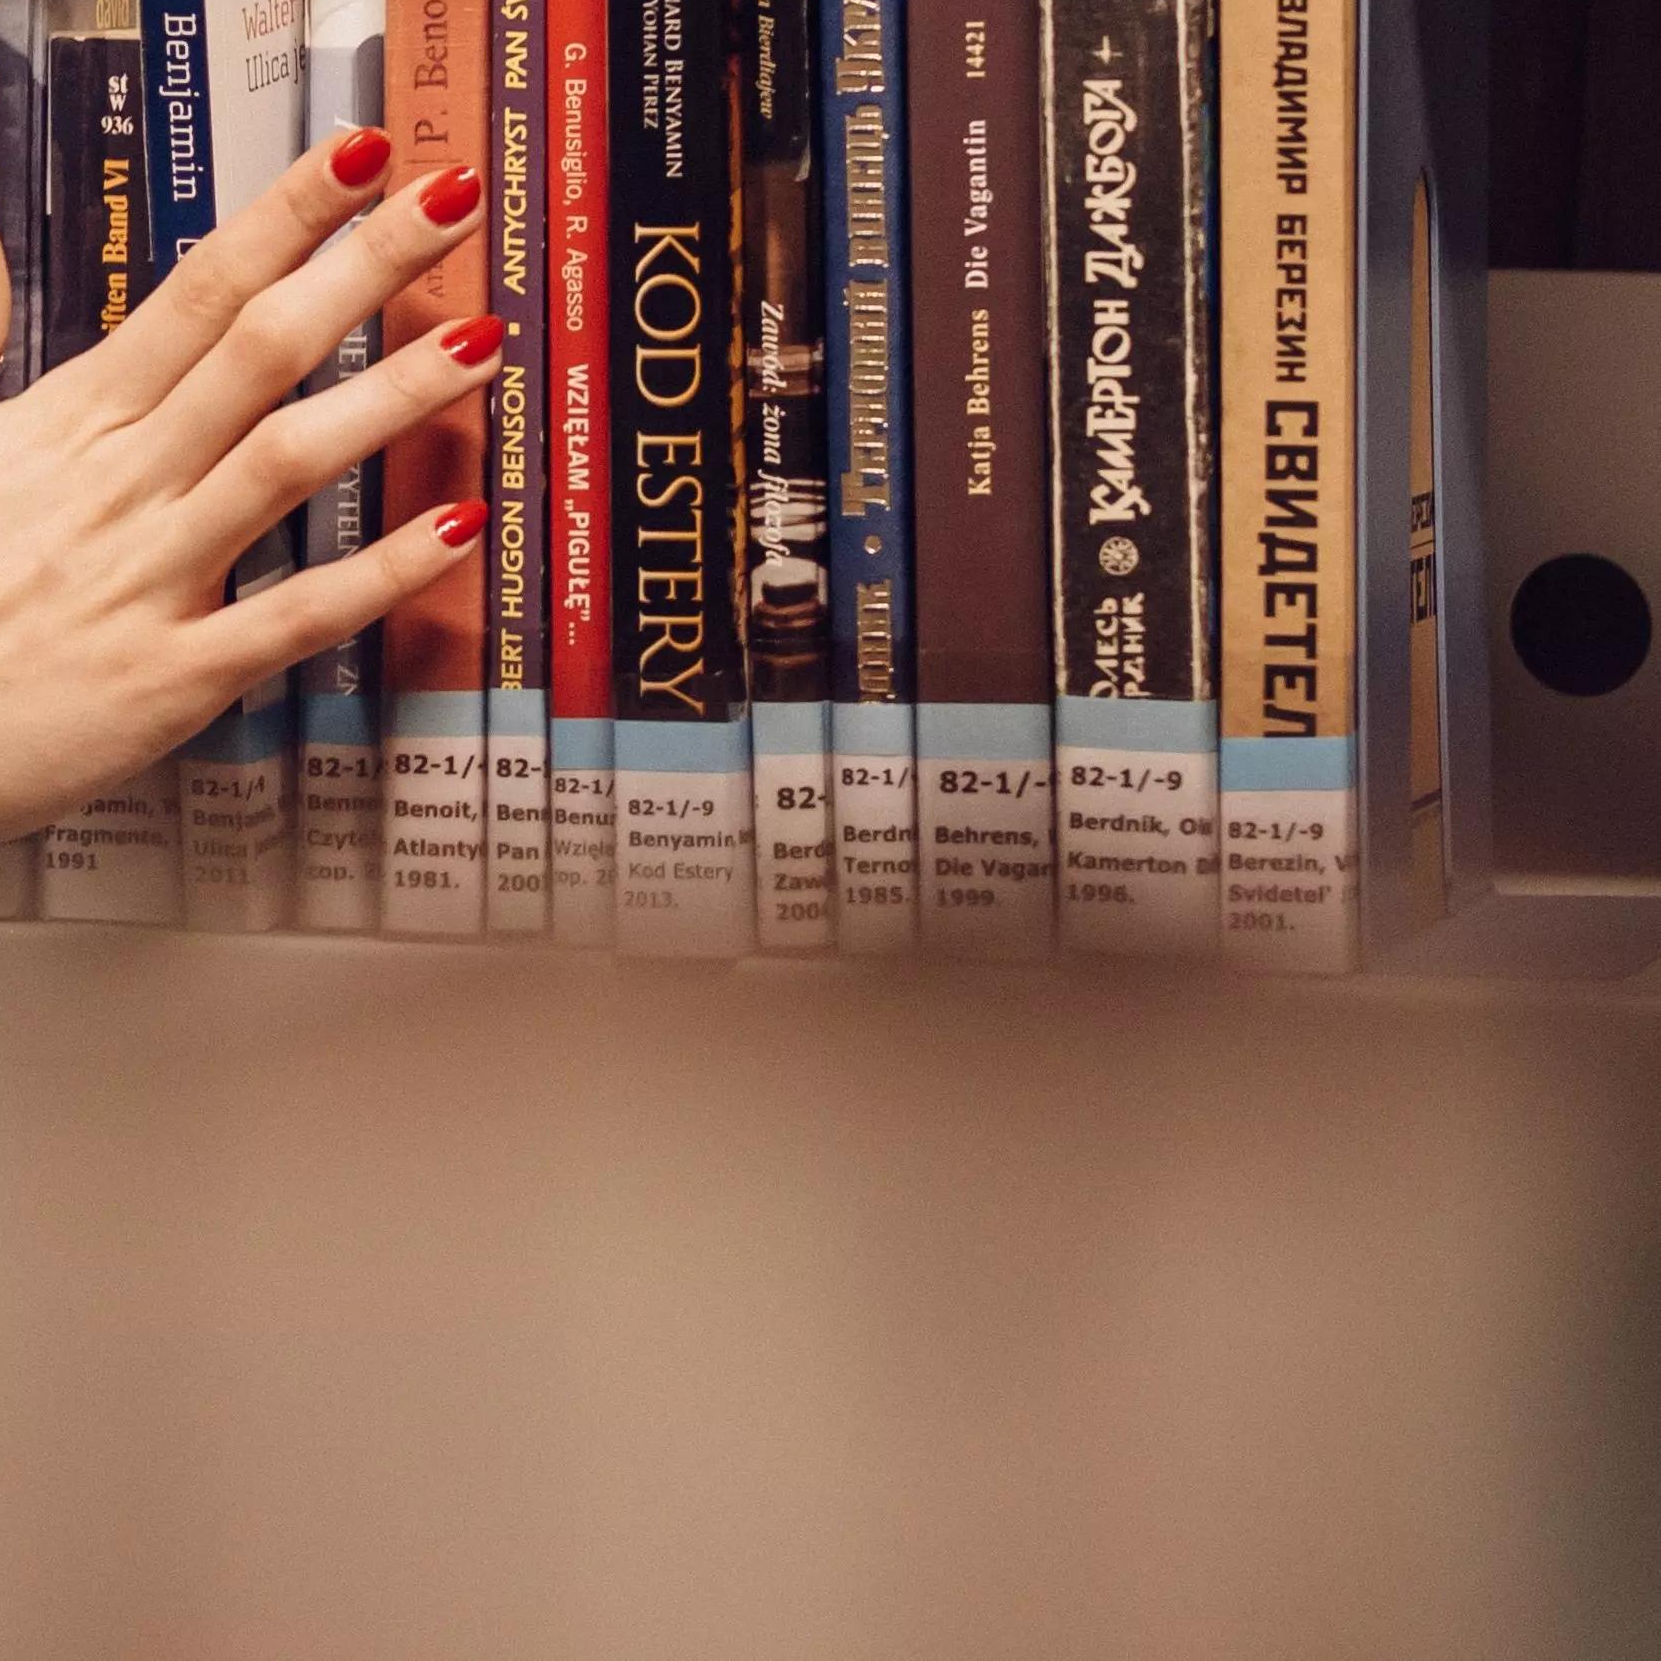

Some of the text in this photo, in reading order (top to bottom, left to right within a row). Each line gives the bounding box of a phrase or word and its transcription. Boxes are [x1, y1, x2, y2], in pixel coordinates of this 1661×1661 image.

[245, 51, 291, 94] Ulica
[503, 29, 527, 90] PAN
[564, 41, 589, 71] G.
[965, 20, 986, 78] 14421
[100, 115, 135, 136] 936
[158, 12, 205, 202] Benjamin
[413, 107, 450, 149] P.
[642, 72, 659, 130] PEREZ
[665, 59, 686, 179] BENYAMIN
[559, 77, 588, 206] Benusiglio,
[101, 158, 130, 264] Band VI
[501, 108, 528, 295] ANTYCHRYST
[565, 214, 589, 243] R.
[560, 247, 588, 333] Agasso
[963, 118, 997, 496] Katja Behrens Die Vagantin
[1275, 213, 1309, 383] БЕРЕЗИН
[760, 299, 788, 394] Zawód:
[502, 366, 526, 490] BENSON
[563, 363, 590, 492] WZIĘŁAM
[762, 402, 787, 465] żona
[634, 221, 706, 714] KOD ESTERY
[500, 500, 525, 621] HUGON
[628, 799, 715, 819] 82-1/-9
[1070, 765, 1184, 793] 82-1/-9
[394, 800, 479, 823] Benoit,
[1227, 820, 1325, 843] 82-1/-9
[394, 871, 461, 890] 1981.
[497, 843, 539, 861] Pan
[1228, 852, 1326, 876] Berezin,
